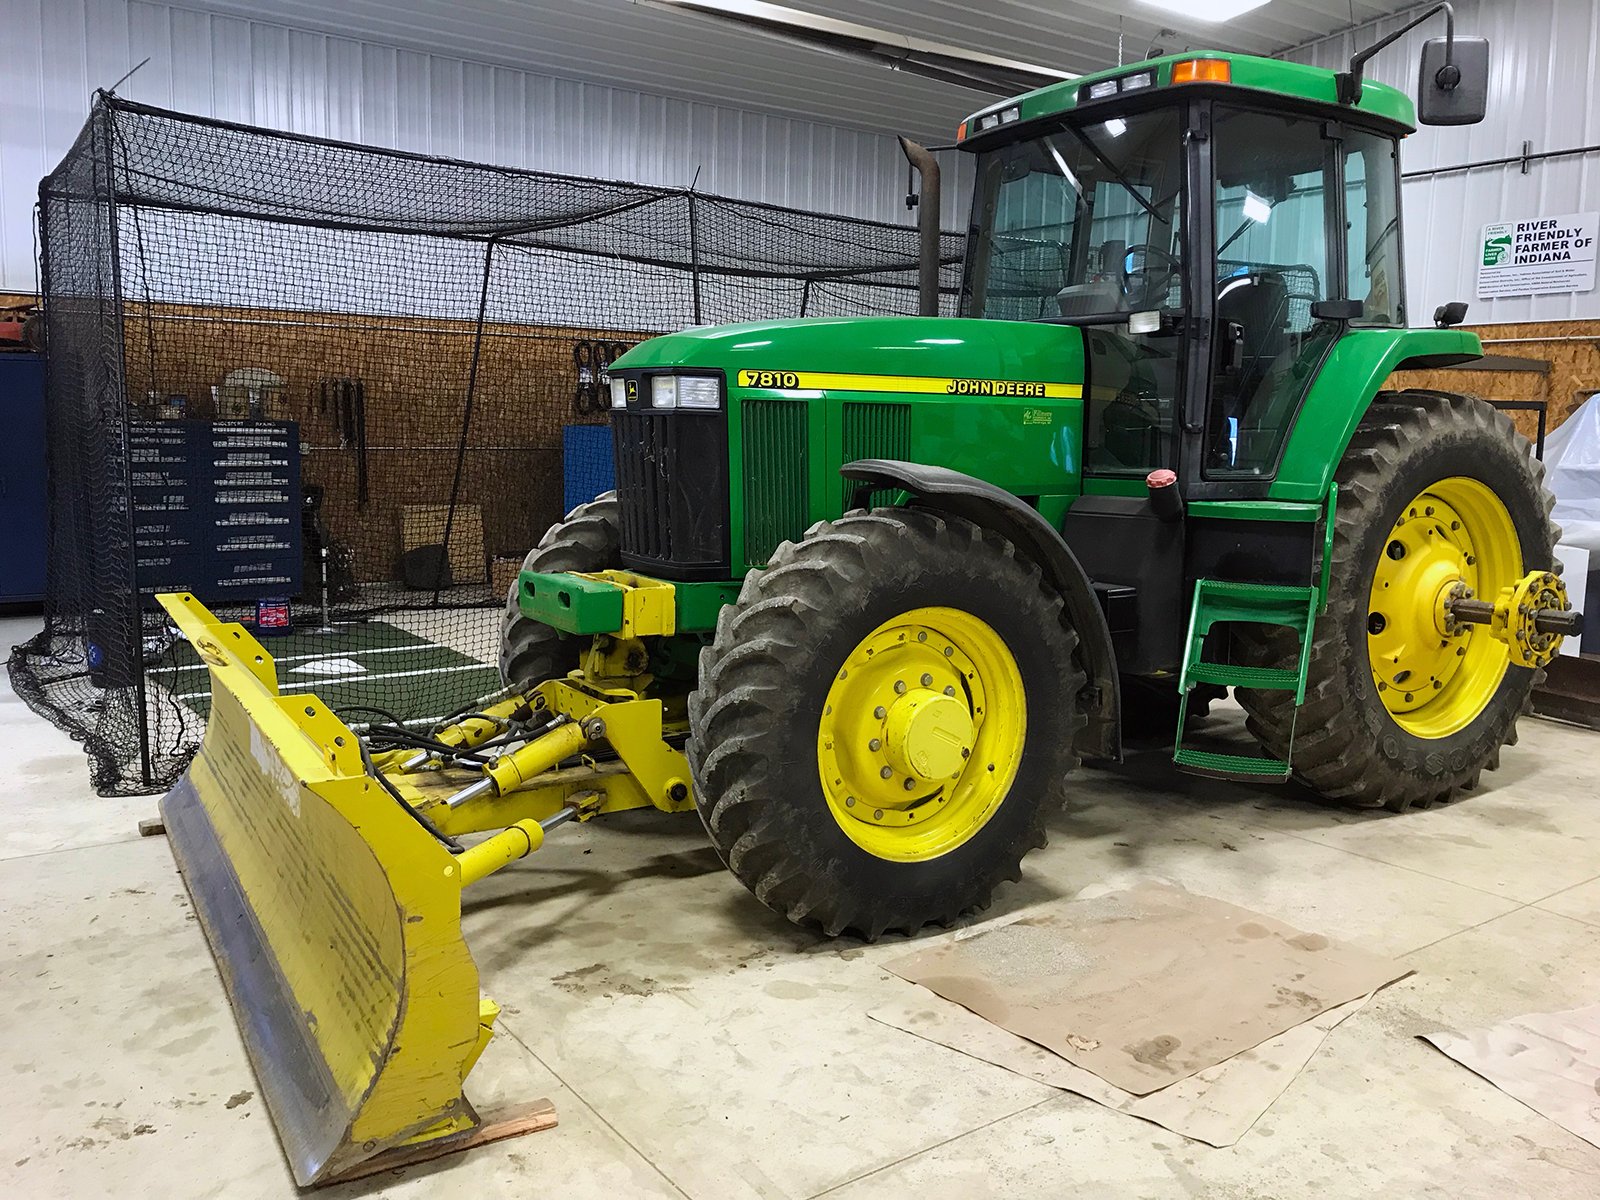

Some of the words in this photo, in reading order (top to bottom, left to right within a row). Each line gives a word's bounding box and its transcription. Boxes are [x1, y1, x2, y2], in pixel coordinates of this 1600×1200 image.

[1517, 219, 1557, 232] RIVER
[1516, 227, 1582, 243] FRIENDLY
[1515, 240, 1569, 254] FARMER
[1574, 238, 1592, 248] OF
[1514, 251, 1571, 264] INDIANA
[746, 371, 799, 389] 7810
[947, 378, 992, 395] JOHN
[995, 381, 1046, 398] DEERE
